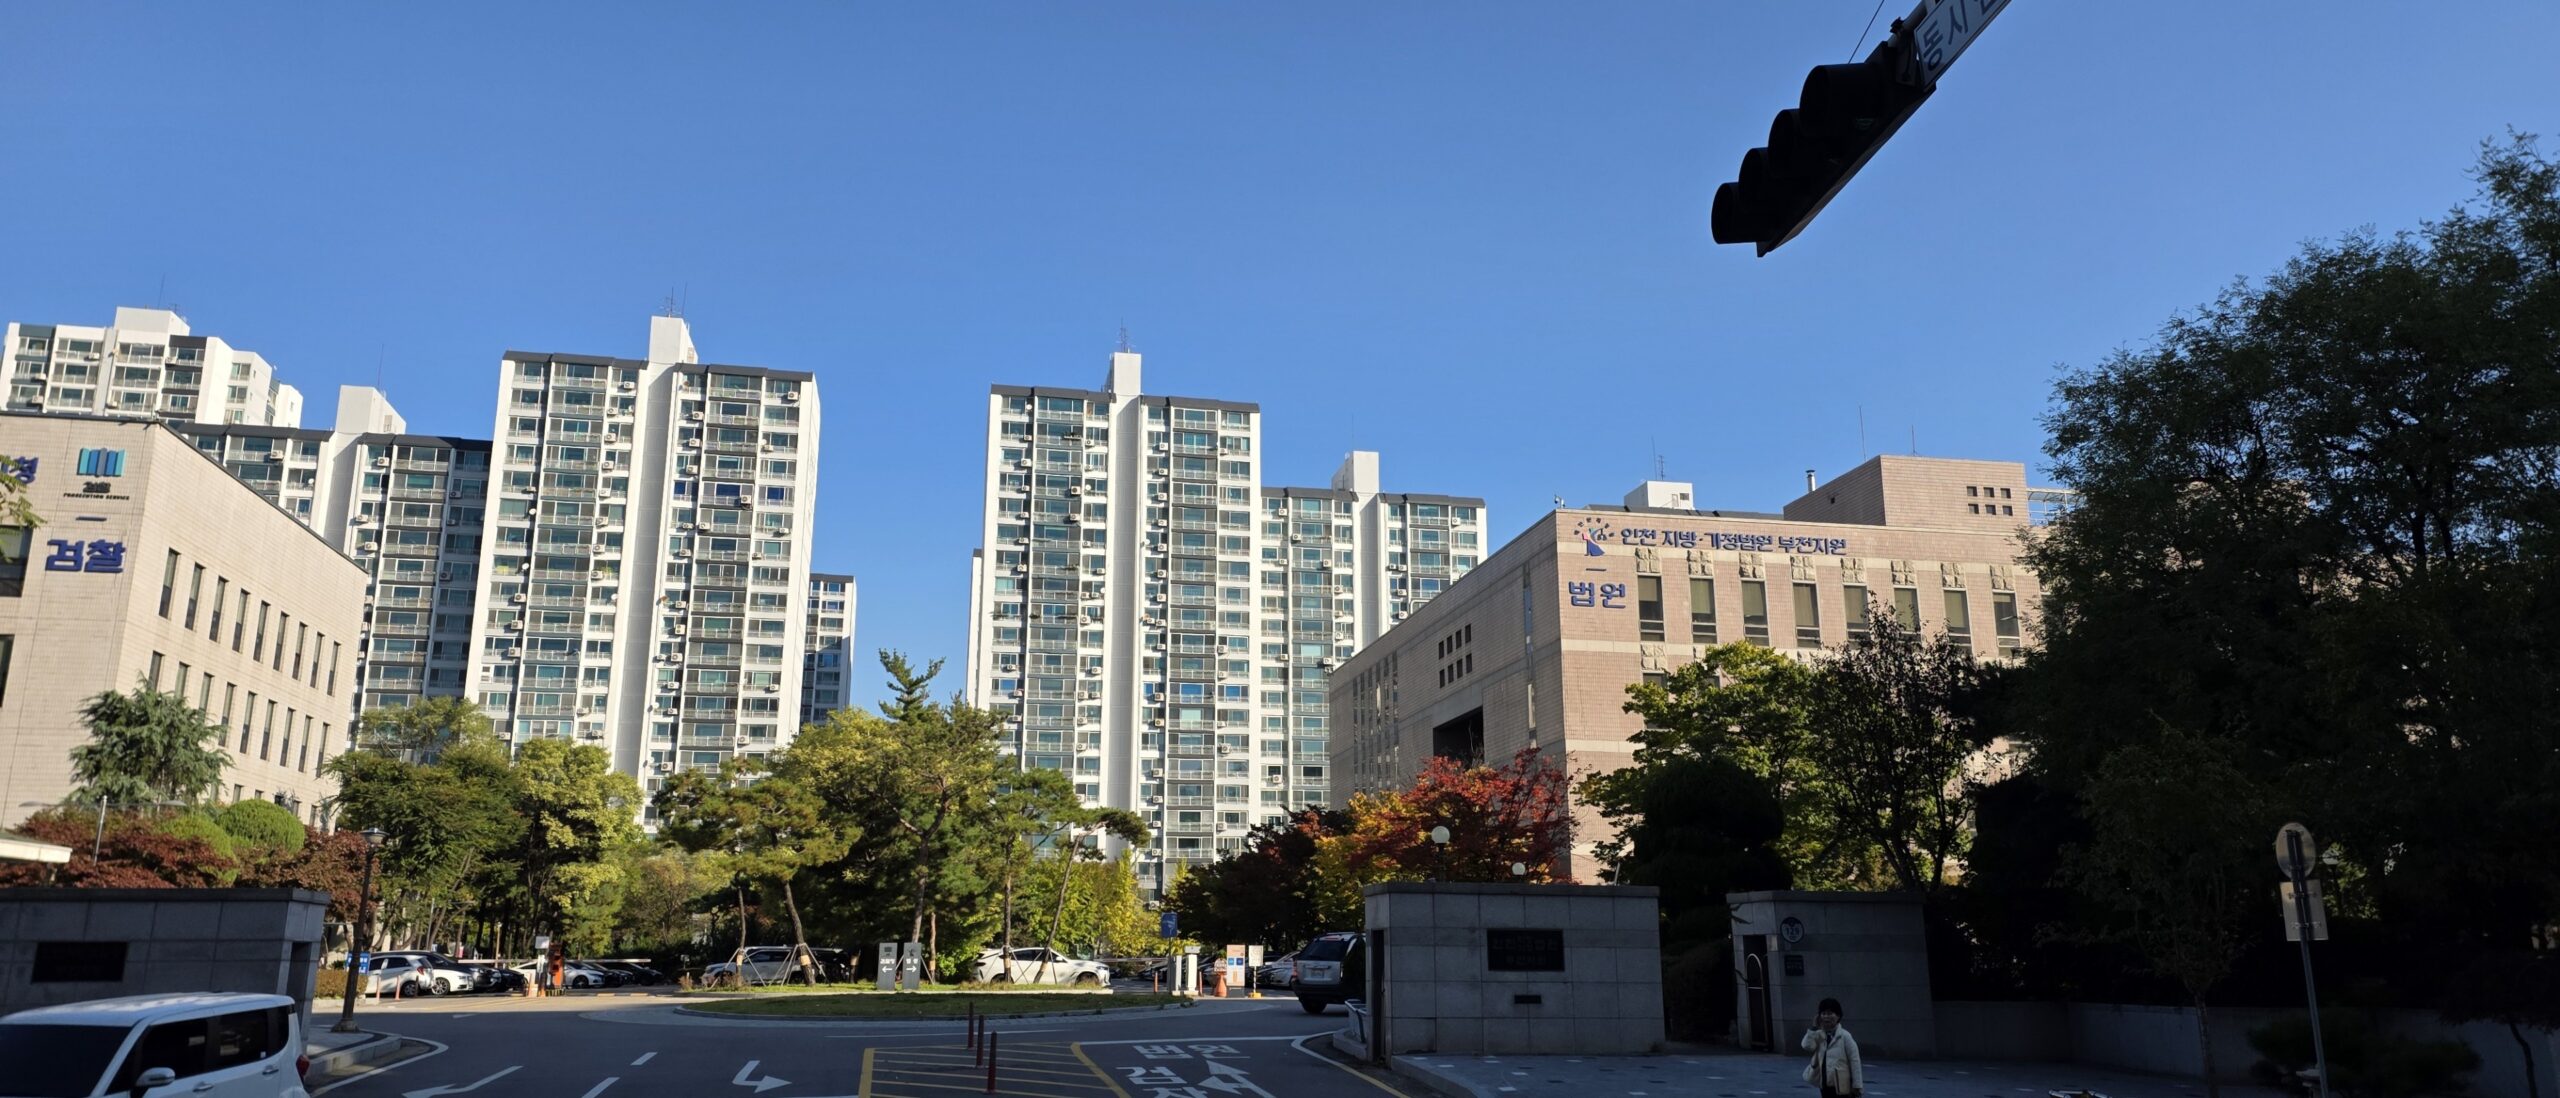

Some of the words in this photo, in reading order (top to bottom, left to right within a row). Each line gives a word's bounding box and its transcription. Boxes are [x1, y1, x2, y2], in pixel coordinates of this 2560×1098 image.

[0, 456, 39, 484] 청
[63, 492, 104, 500] PROSECUTION
[1620, 527, 1657, 547] 인천
[1777, 535, 1848, 556] 부천지원
[45, 539, 126, 573] 검찰
[1568, 581, 1627, 609] 법원
[1132, 1044, 1251, 1059] 법원
